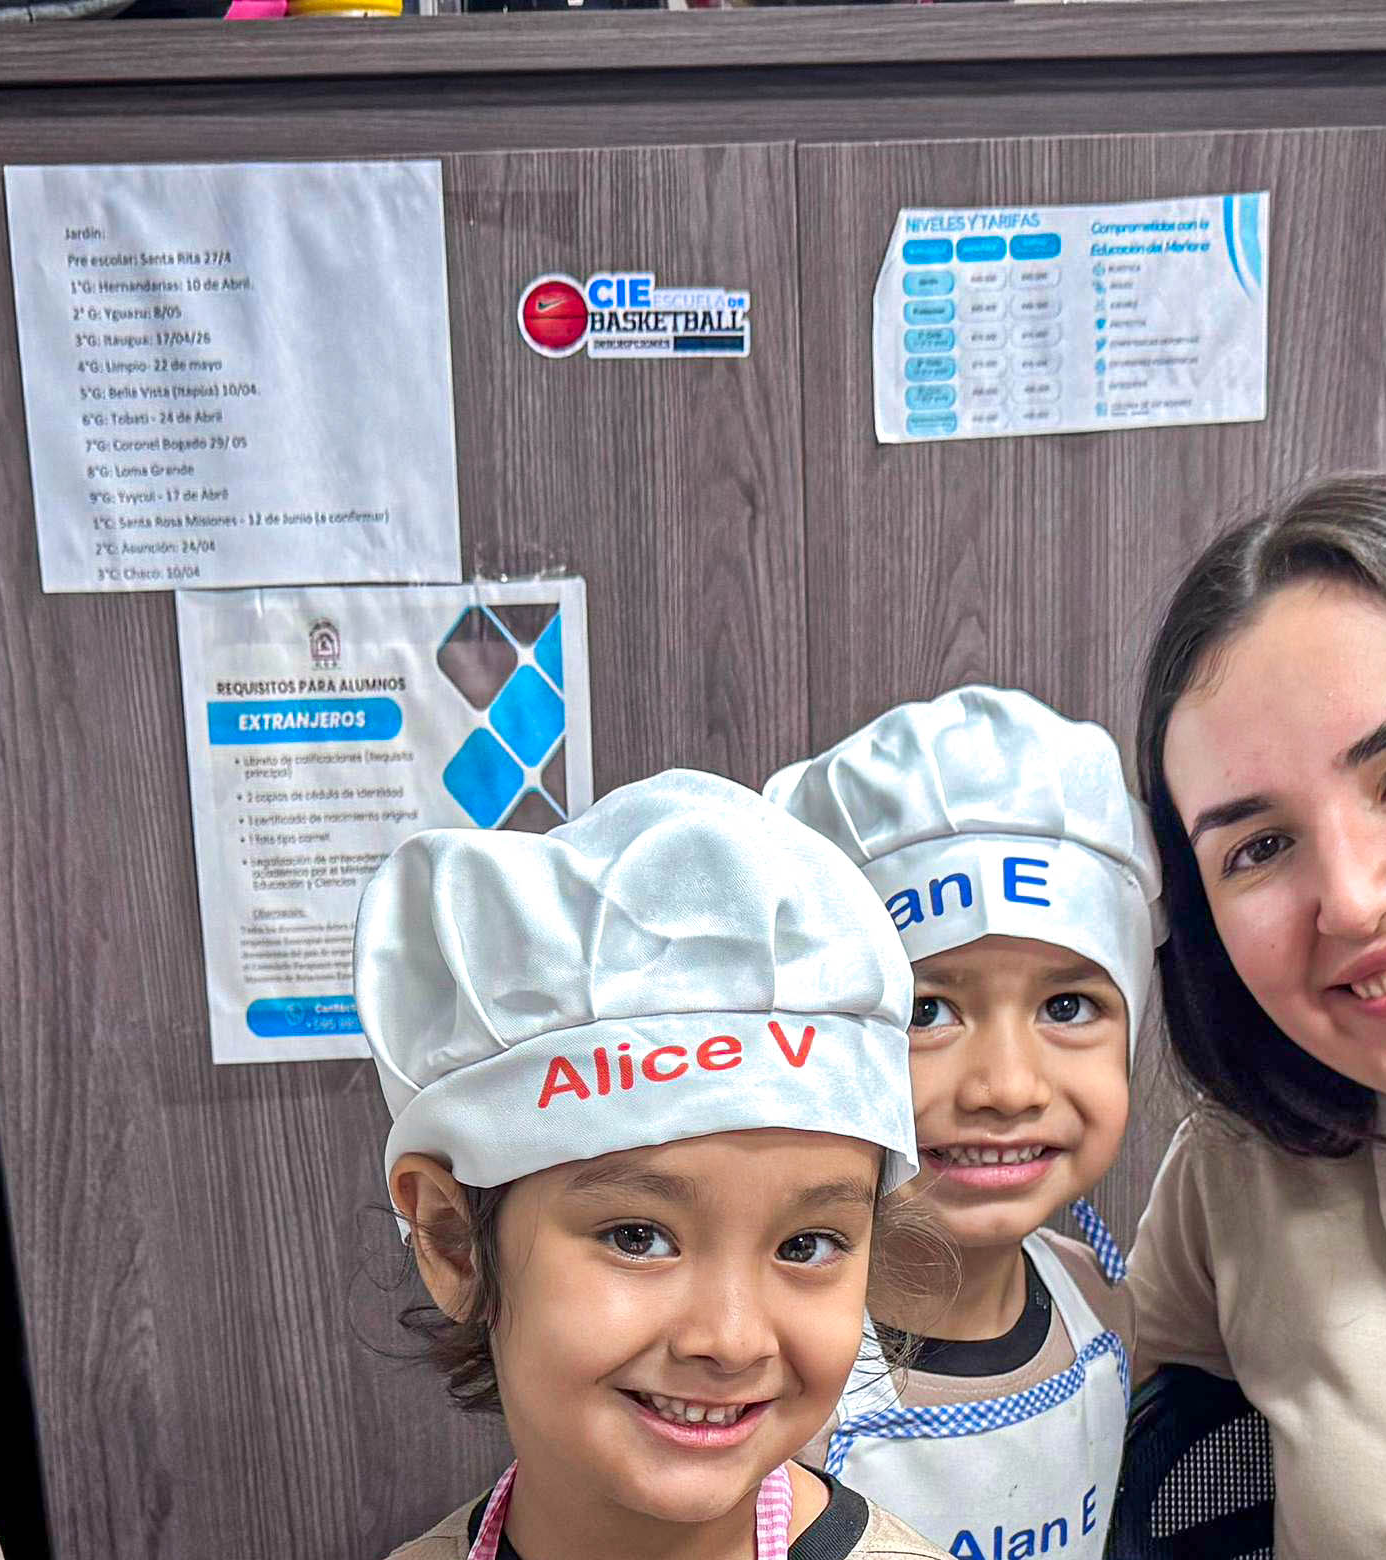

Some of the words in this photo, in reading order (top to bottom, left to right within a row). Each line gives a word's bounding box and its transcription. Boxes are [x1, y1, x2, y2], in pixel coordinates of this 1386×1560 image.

[905, 215, 964, 233] NIVELES
[981, 213, 1040, 231] TARIFAS
[68, 254, 86, 267] Pre
[140, 253, 175, 266] Santa
[177, 252, 201, 265] Rita
[186, 279, 201, 292] 10
[204, 279, 219, 291] de
[589, 278, 651, 309] CIE
[590, 311, 744, 332] BASKETBALL
[154, 359, 168, 372] 22
[170, 359, 186, 372] de
[189, 360, 223, 374] mayo
[160, 411, 174, 424] 24
[176, 411, 192, 424] de
[150, 463, 195, 478] Grande
[183, 489, 198, 502] de
[155, 515, 184, 529] Rosa
[265, 512, 281, 526] de
[216, 680, 296, 697] REQUISITOS
[299, 678, 335, 694] PARA
[340, 677, 406, 693] ALUMNOS
[238, 711, 365, 731] EXTRANJEROS
[888, 870, 973, 932] an
[1002, 856, 1051, 907] E
[538, 1034, 743, 1108] Alice
[767, 1021, 816, 1068] V
[1081, 1484, 1097, 1536] E
